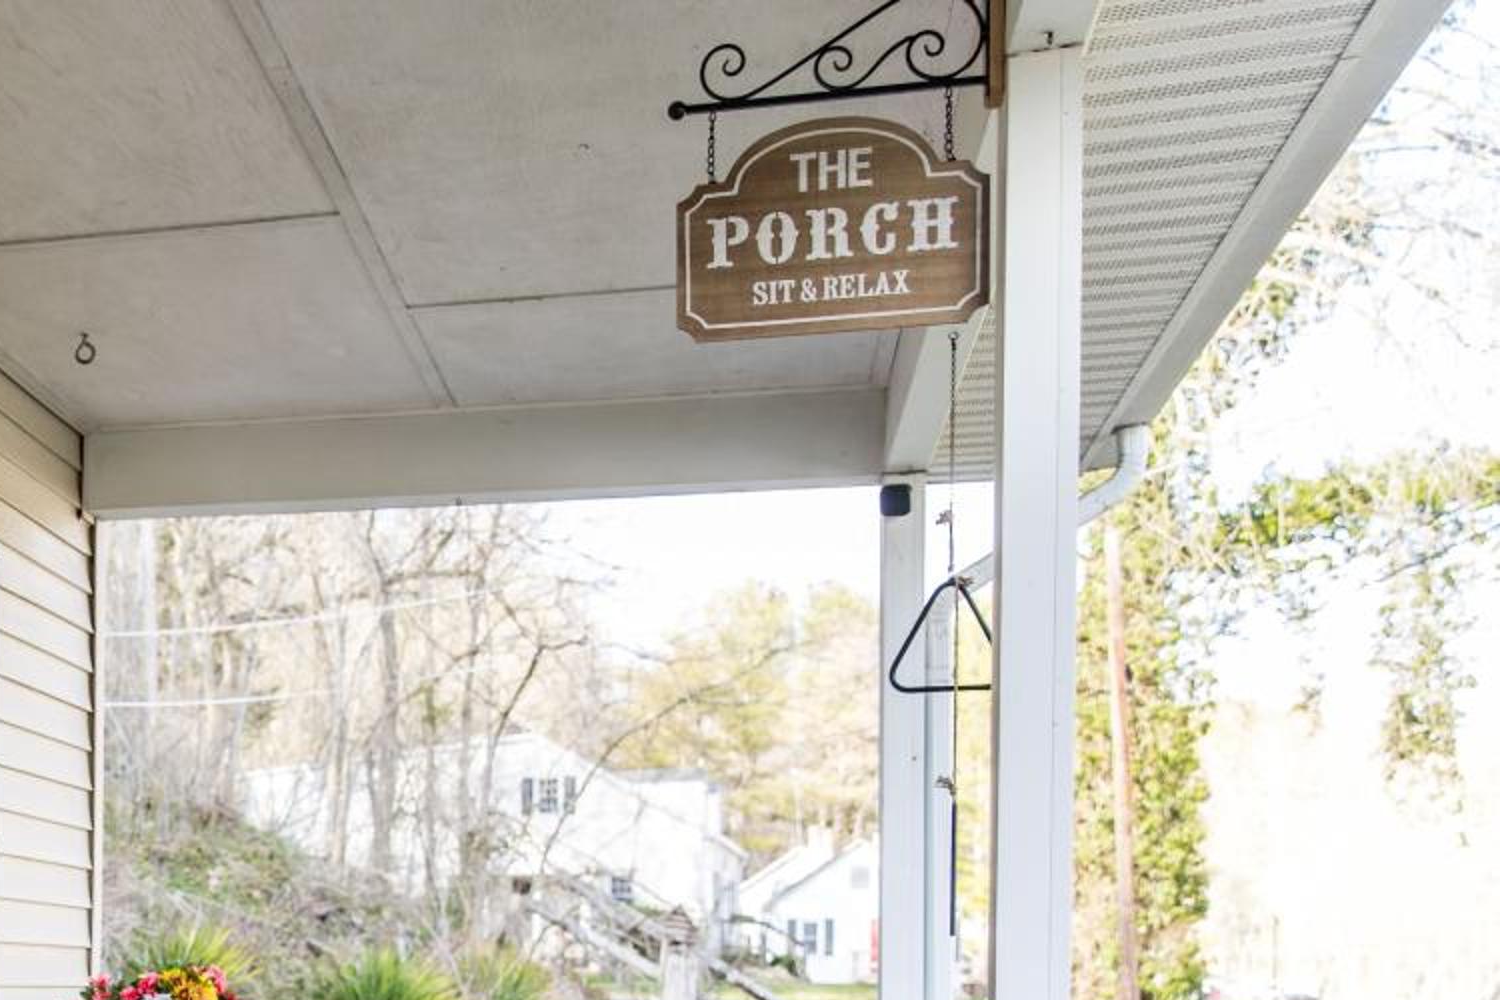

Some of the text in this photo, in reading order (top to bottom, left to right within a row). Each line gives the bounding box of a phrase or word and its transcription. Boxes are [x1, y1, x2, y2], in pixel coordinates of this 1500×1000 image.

[789, 147, 874, 193] THE
[705, 195, 960, 269] PORCH
[752, 269, 912, 306] SIT & RELAX
